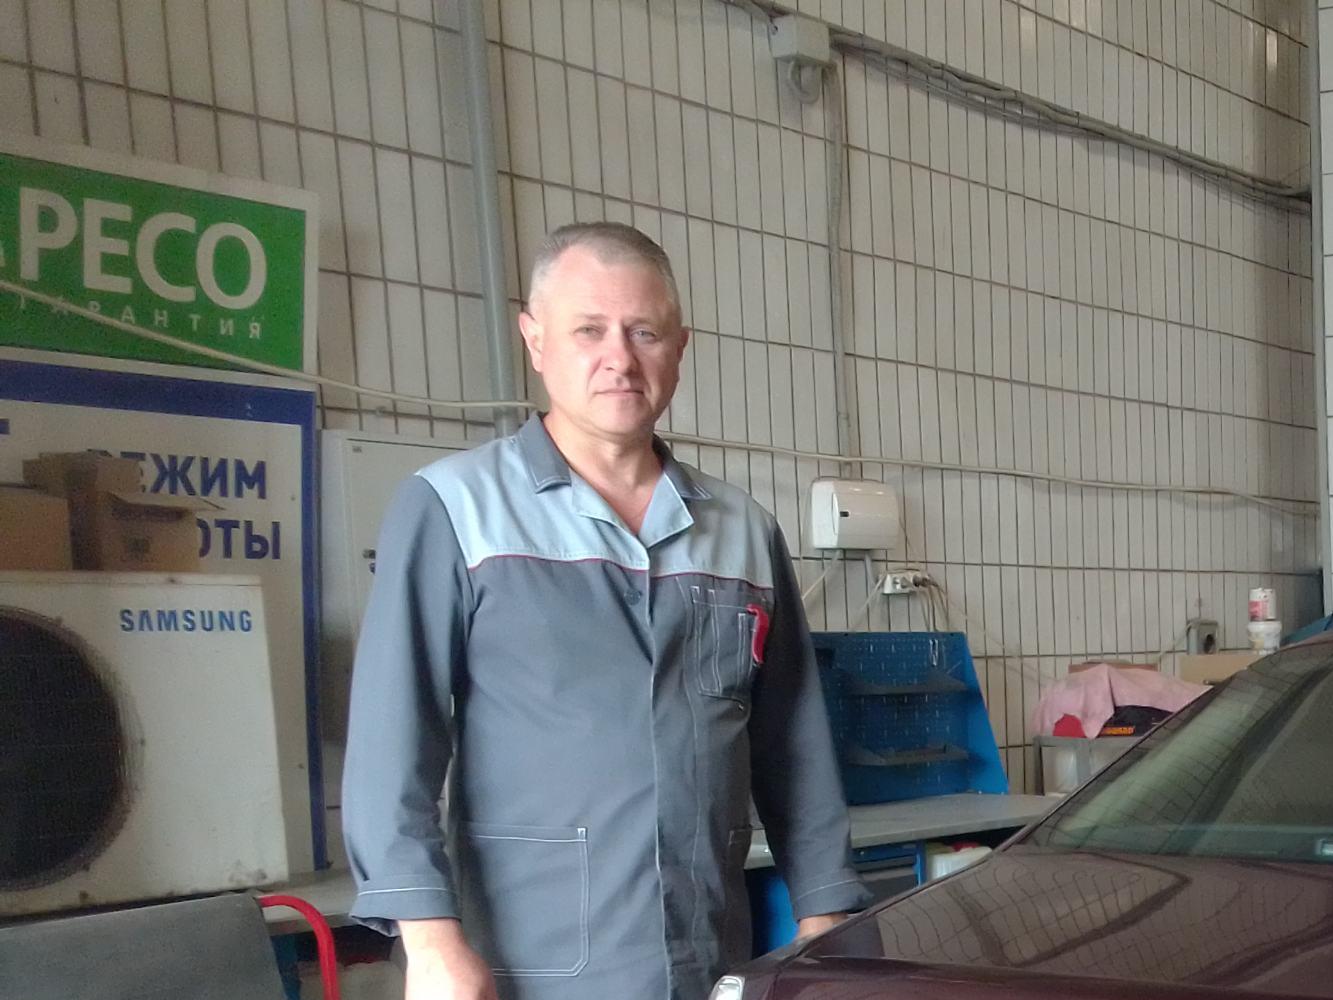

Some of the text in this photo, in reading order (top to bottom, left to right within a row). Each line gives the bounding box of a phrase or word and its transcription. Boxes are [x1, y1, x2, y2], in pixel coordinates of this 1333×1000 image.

[19, 186, 267, 310] РЕСО
[87, 449, 267, 500] ЖИМ
[120, 608, 252, 633] SAMSUNG
